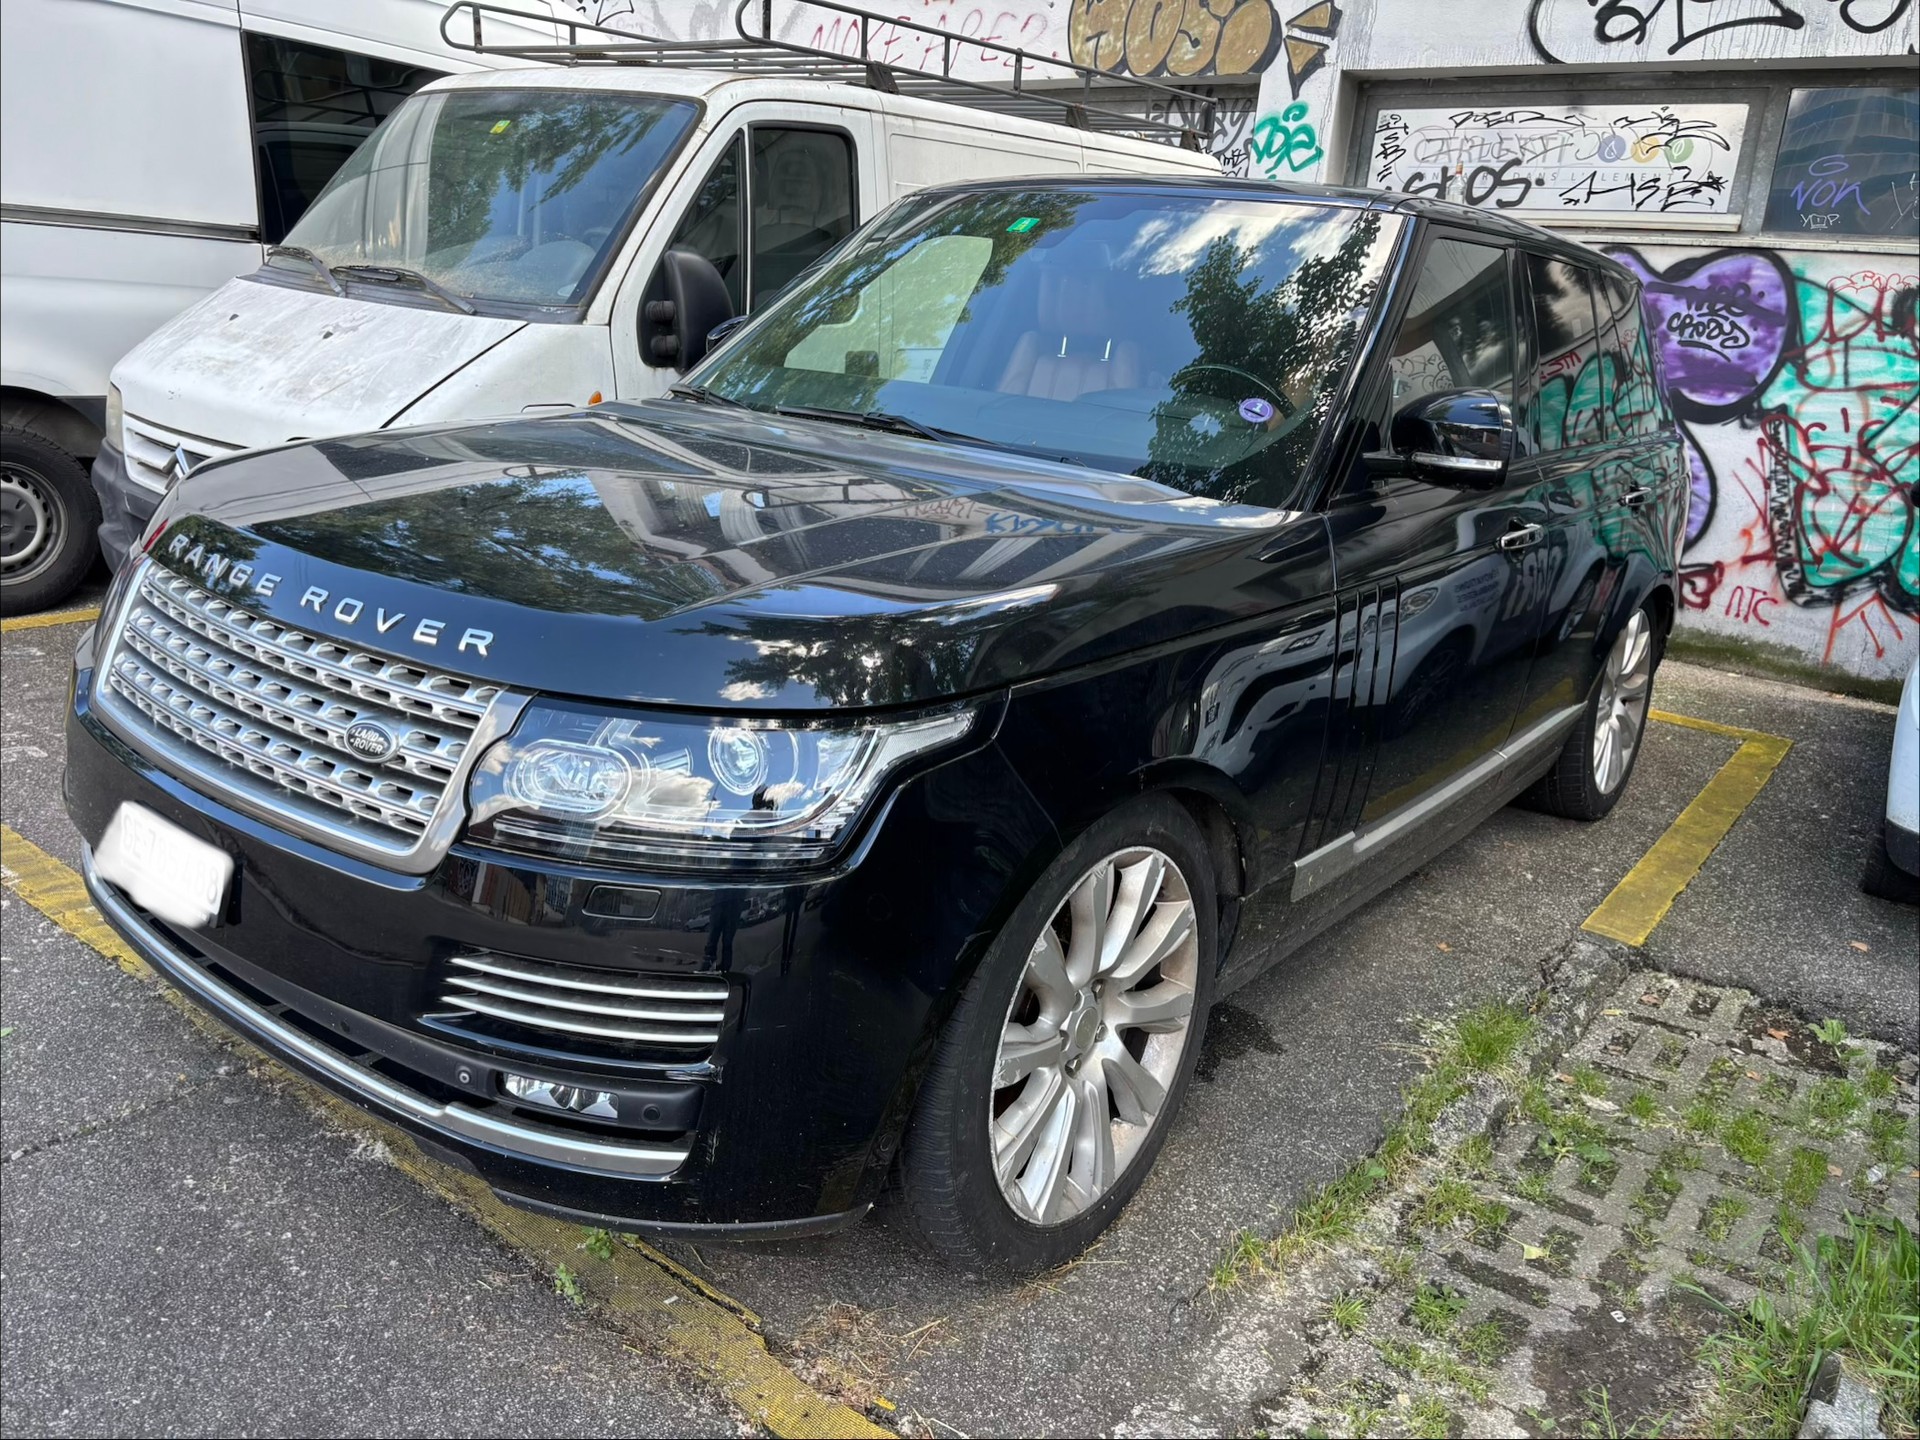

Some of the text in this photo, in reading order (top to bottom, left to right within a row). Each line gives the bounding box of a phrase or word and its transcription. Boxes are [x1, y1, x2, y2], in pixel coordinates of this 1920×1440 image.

[1571, 172, 1674, 182] L'LEMENT
[169, 533, 494, 657] RANGE ROVER
[355, 728, 379, 742] LAND
[353, 738, 383, 755] ROVER
